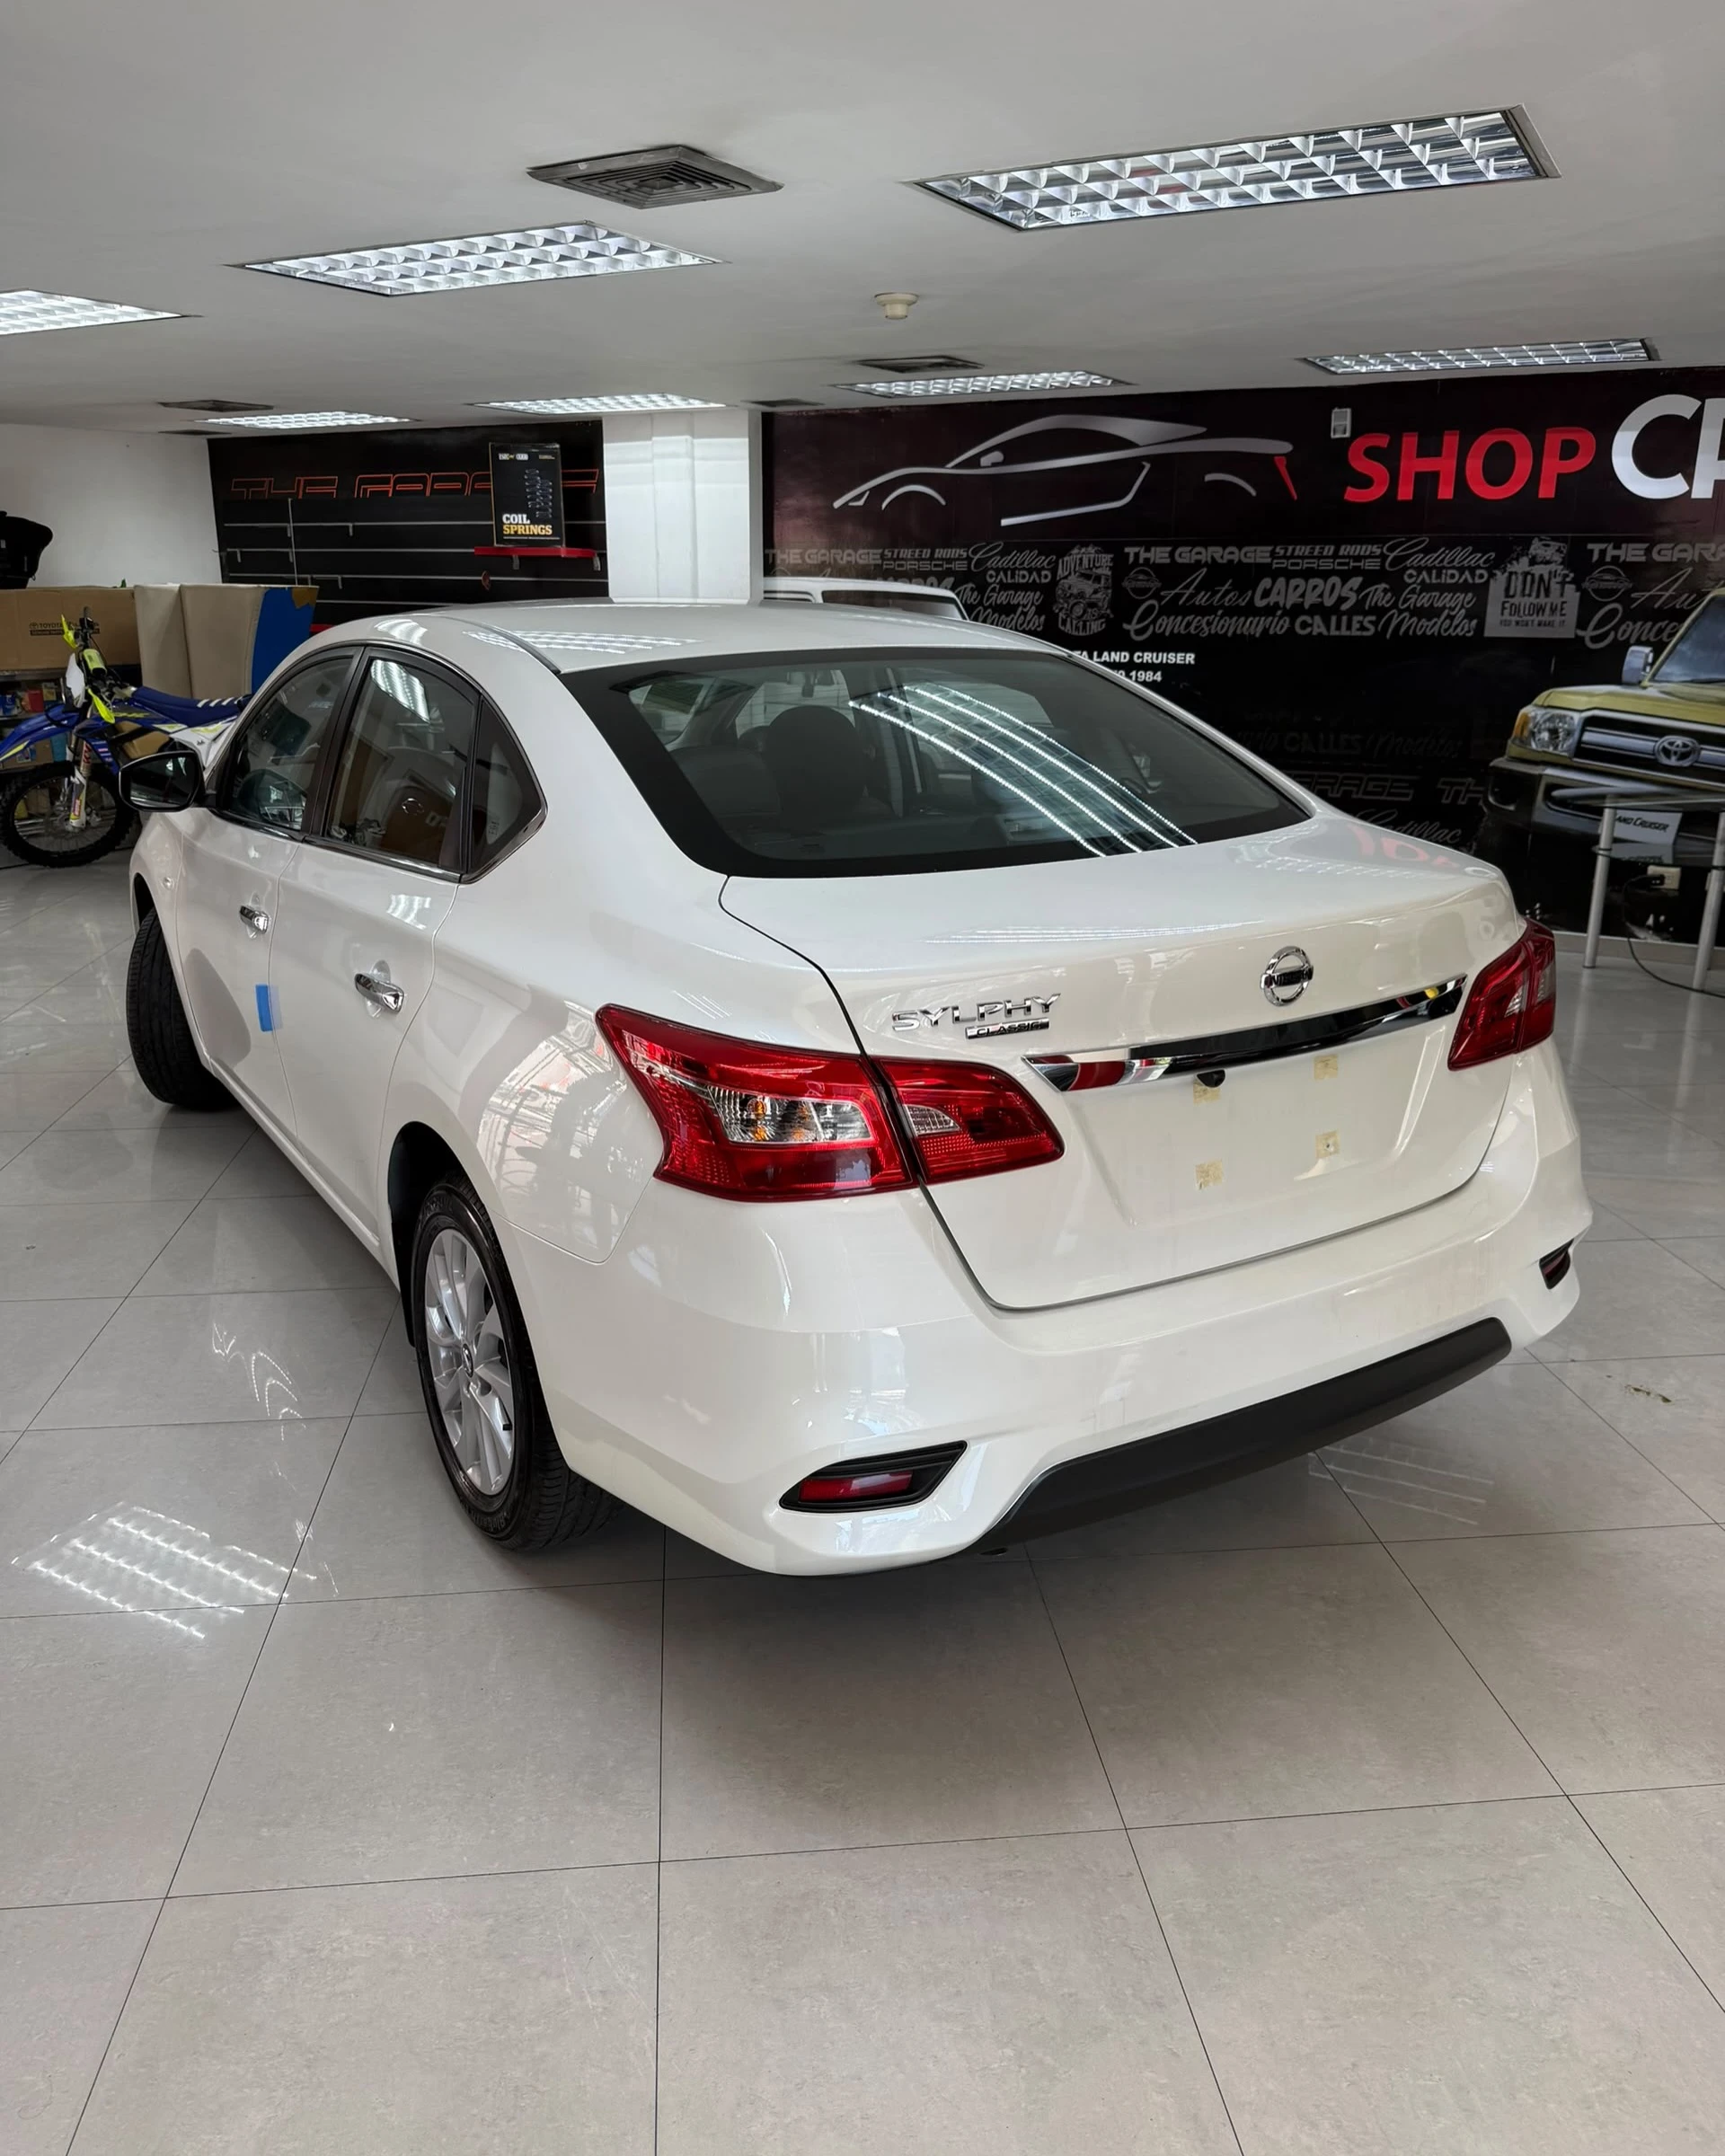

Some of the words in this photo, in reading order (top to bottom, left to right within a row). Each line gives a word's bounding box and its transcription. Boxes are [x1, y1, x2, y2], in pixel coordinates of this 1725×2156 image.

[1343, 427, 1596, 503] SHOP
[502, 513, 530, 524] COIL
[503, 525, 553, 535] SPRINGS
[765, 548, 802, 565] THE
[804, 548, 883, 565] GARAGE
[968, 541, 1057, 572] Cadillac
[1123, 544, 1172, 565] THE
[1174, 544, 1275, 565] GARAGE
[1382, 536, 1496, 571] Cadillac
[1587, 542, 1650, 562] THE
[882, 561, 969, 571] PORSCHE
[1057, 553, 1114, 580] ADVENTURE
[1271, 558, 1382, 570] PORSCHE
[955, 582, 981, 605] The
[983, 584, 1044, 613] Garage
[1160, 567, 1253, 606] Autos
[1253, 575, 1364, 612] CARROS
[1358, 582, 1396, 611] The
[1397, 584, 1477, 616] Garage
[969, 605, 1047, 632] Modelos
[1500, 601, 1546, 618] FOLLOW
[1550, 601, 1568, 617] ME
[1058, 613, 1106, 636] CALLING
[1121, 599, 1291, 641] Concesionario
[1293, 614, 1377, 636] CALLES
[1377, 609, 1479, 640] Modelos
[1092, 650, 1130, 663] LAND
[1132, 651, 1196, 665] CRUISER
[1129, 669, 1163, 683] 1984
[1614, 815, 1634, 825] AND
[892, 993, 1061, 1032] SYLPHY
[976, 1021, 1042, 1038] CLASSIC
